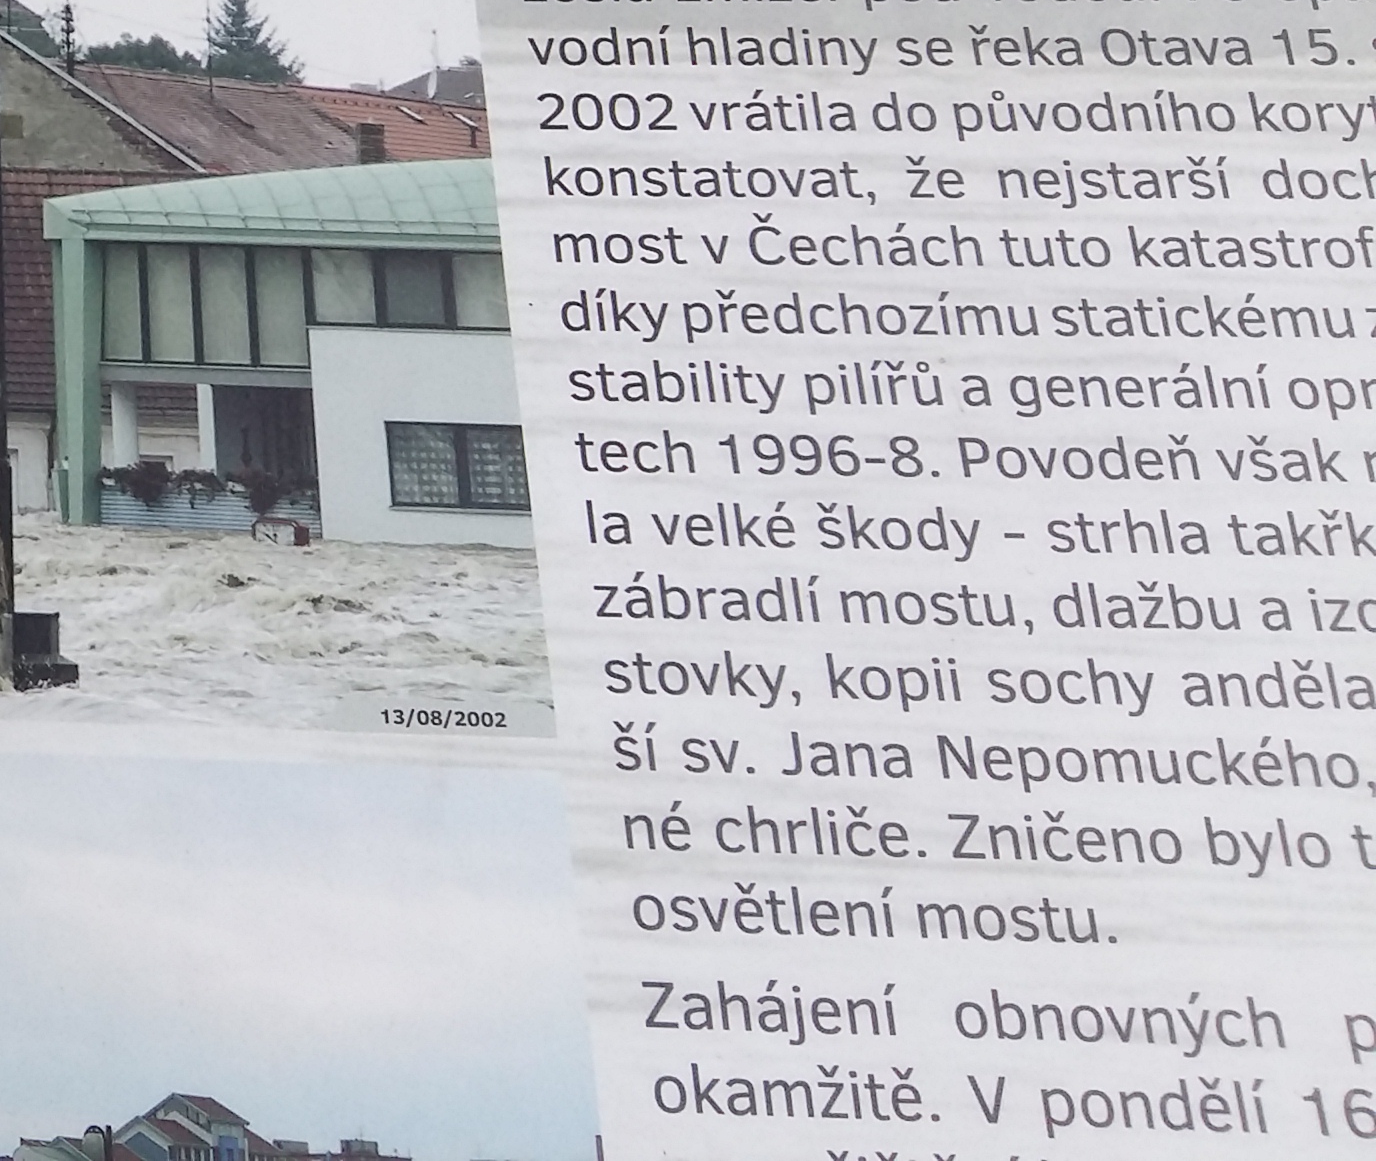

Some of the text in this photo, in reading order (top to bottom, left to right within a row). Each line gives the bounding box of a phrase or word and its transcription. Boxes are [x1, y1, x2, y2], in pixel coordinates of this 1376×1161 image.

[528, 25, 1355, 75] vodní hladiny se řeka Otava 15.
[537, 93, 677, 131] 2002
[689, 89, 856, 131] vrátila
[873, 92, 937, 132] do
[953, 90, 1235, 141] původního
[544, 156, 876, 205] konstatovat,
[906, 156, 965, 198] že
[998, 156, 1229, 209] nejstarší
[553, 227, 688, 264] most
[701, 235, 728, 264] v
[749, 213, 984, 266] Čechách
[999, 229, 1110, 267] tuto
[561, 288, 668, 342] díky
[683, 289, 1039, 343] předchozímu
[1052, 293, 1355, 338] statickému
[569, 360, 785, 414] stability
[804, 360, 943, 415] pilířů
[961, 375, 992, 406] a
[1010, 363, 1270, 417] generální
[574, 430, 695, 473] tech
[719, 434, 940, 477] 1996-8.
[958, 434, 1200, 480] Povodeň
[1216, 435, 1348, 482] však
[586, 500, 632, 544] la
[651, 501, 795, 548] velké
[817, 502, 980, 562] škody
[1048, 509, 1210, 555] strhla
[594, 571, 820, 622] zábradlí
[840, 585, 1033, 635] mostu,
[1053, 581, 1241, 630] dlažbu
[1260, 597, 1292, 631] a
[605, 650, 1376, 717] stovky, kopii sochy anděla
[381, 709, 507, 729] 13/08/2002
[613, 721, 656, 771] ší
[682, 738, 755, 774] sv.
[782, 732, 913, 778] Jana
[624, 801, 691, 851] né
[716, 805, 926, 857] chrliče.
[948, 810, 1182, 864] Zničeno
[1204, 817, 1330, 878] bylo
[633, 882, 1117, 943] osvětlení mostu.
[642, 980, 896, 1045] Zahájení
[955, 989, 1286, 1057] obnovných
[654, 1063, 940, 1122] okamžitě.
[967, 1075, 1005, 1123] V
[1041, 1077, 1267, 1138] pondělí
